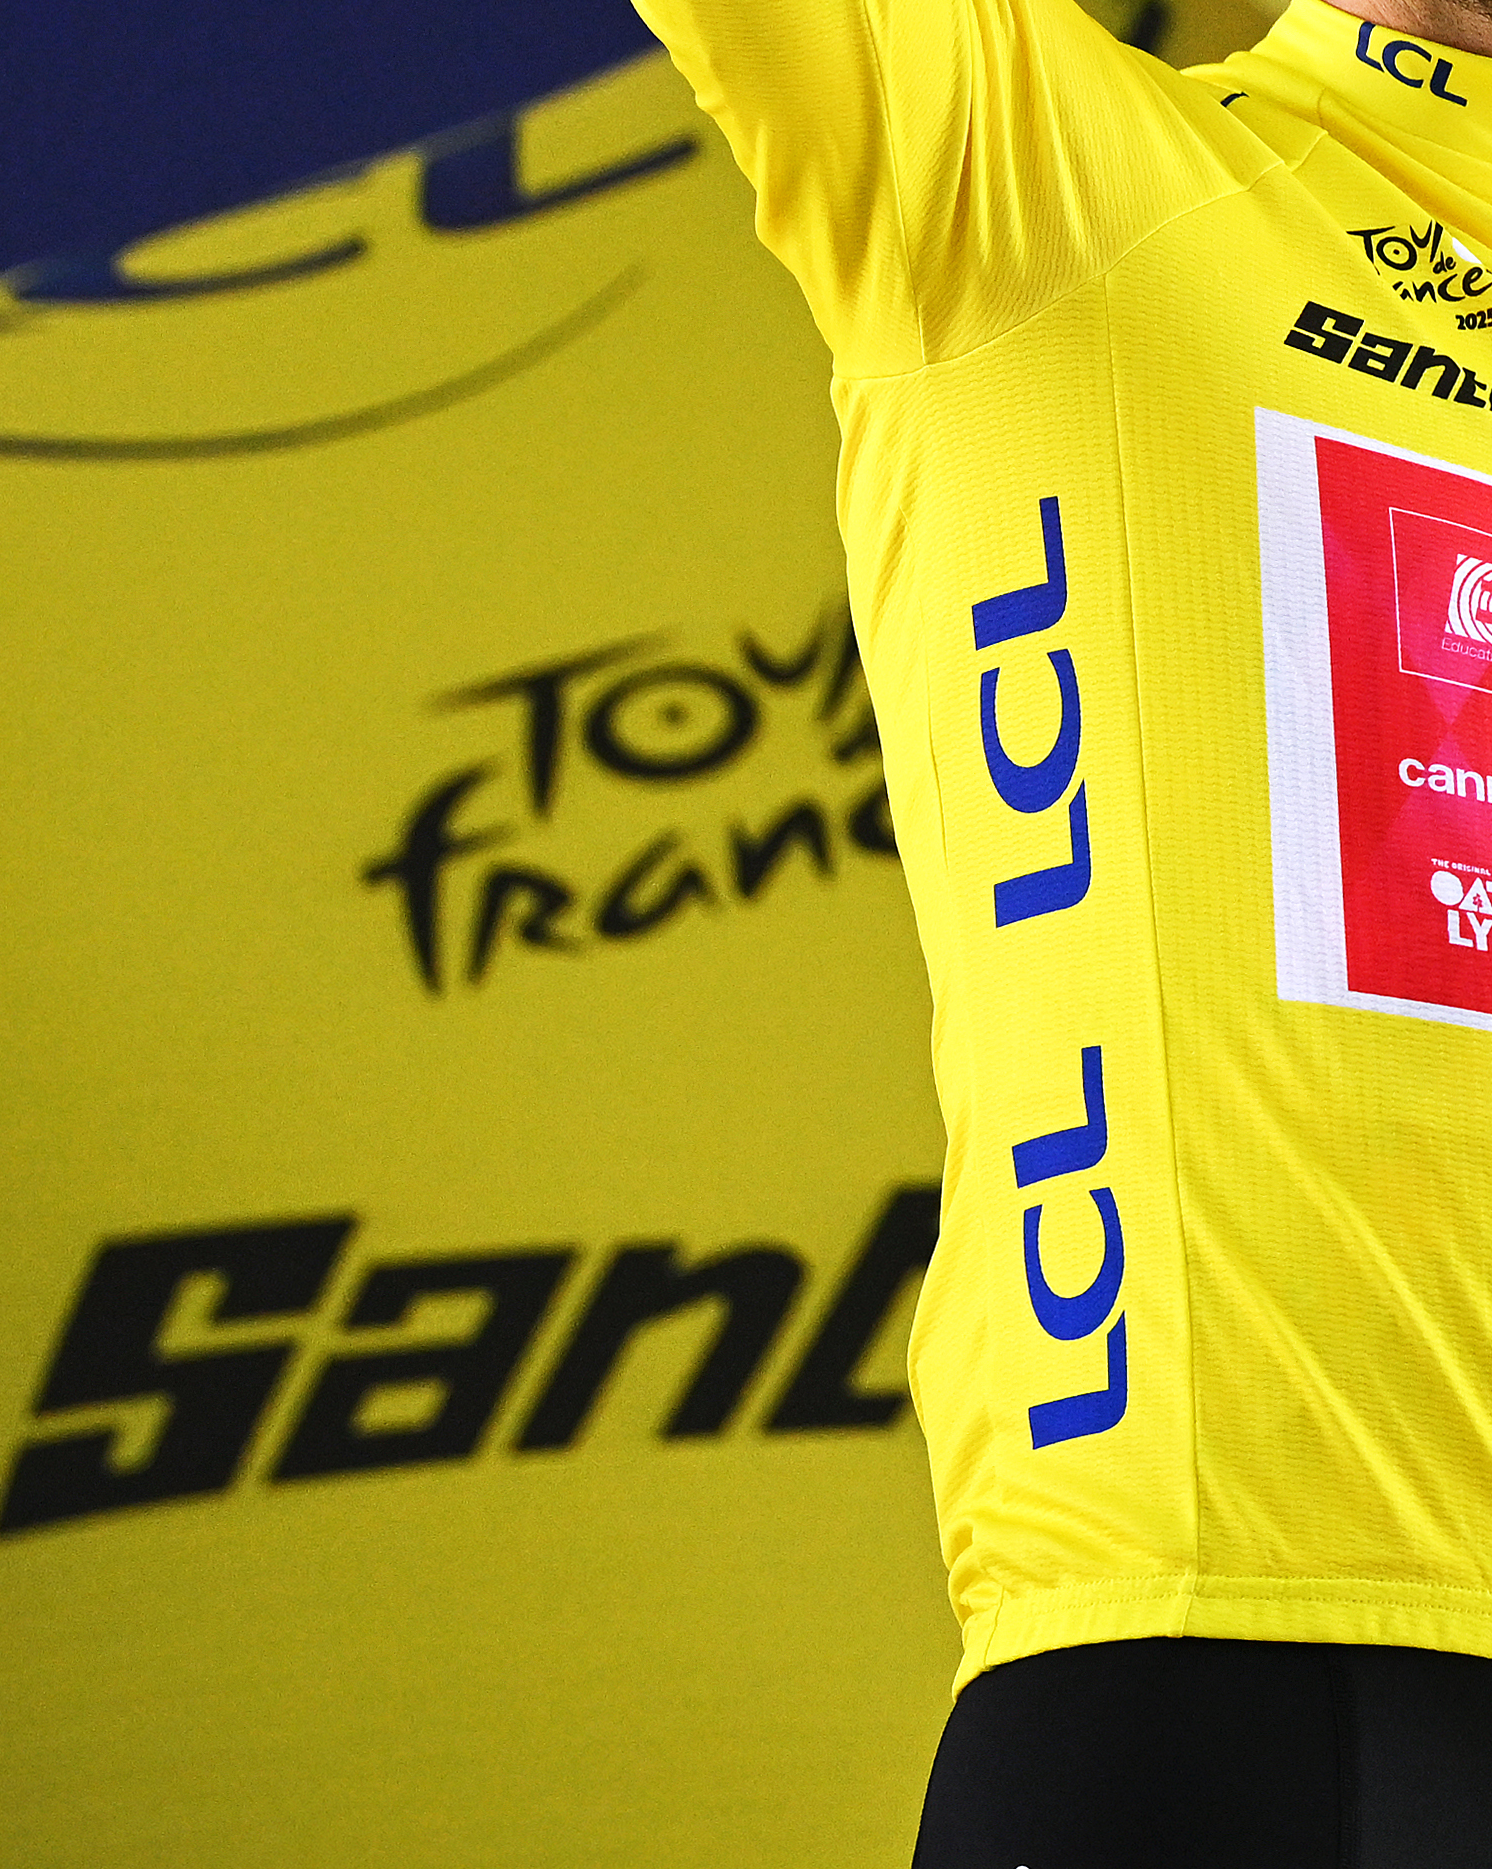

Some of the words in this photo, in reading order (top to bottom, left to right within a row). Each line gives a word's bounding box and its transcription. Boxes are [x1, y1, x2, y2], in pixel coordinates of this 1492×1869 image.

[1355, 20, 1468, 108] LCL
[1433, 251, 1456, 274] de
[971, 495, 1092, 928] LCL
[1431, 858, 1450, 869] THE
[1451, 862, 1492, 876] ORIGINAL
[1011, 1044, 1128, 1452] LCL
